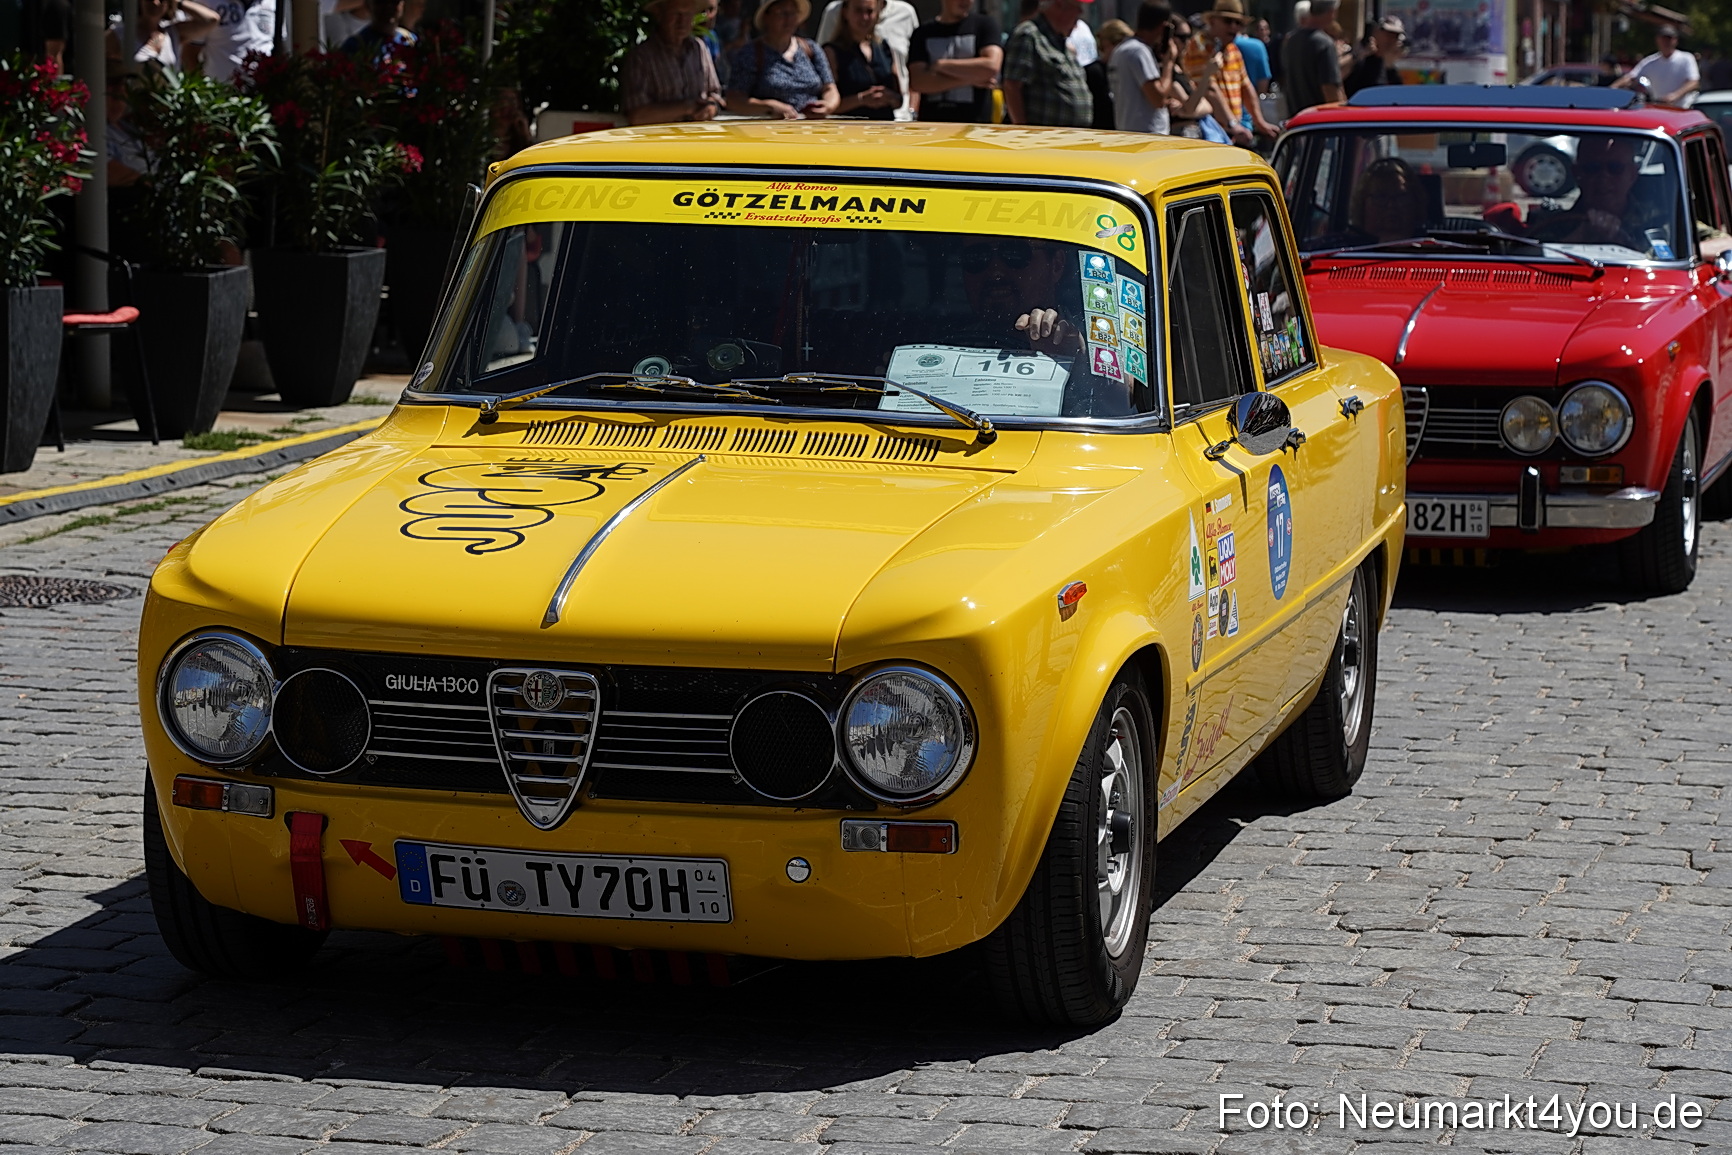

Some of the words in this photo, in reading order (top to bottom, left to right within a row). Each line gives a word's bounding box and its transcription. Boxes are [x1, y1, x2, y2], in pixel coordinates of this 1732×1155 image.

[765, 182, 794, 192] Alfa
[796, 183, 838, 192] Romeo
[494, 185, 641, 221] RACING
[672, 188, 927, 214] GÖTZELMANN
[744, 212, 842, 224] Ersatzteilprofis
[962, 196, 1098, 232] TEAM
[977, 360, 1036, 376] 116
[1469, 504, 1483, 512] 04
[1470, 523, 1483, 533] 10
[1218, 534, 1235, 562] LIQUI
[1220, 558, 1236, 585] MOLY
[430, 854, 492, 902] FÜ
[693, 869, 717, 883] 04
[409, 879, 422, 893] D
[699, 901, 720, 914] 10
